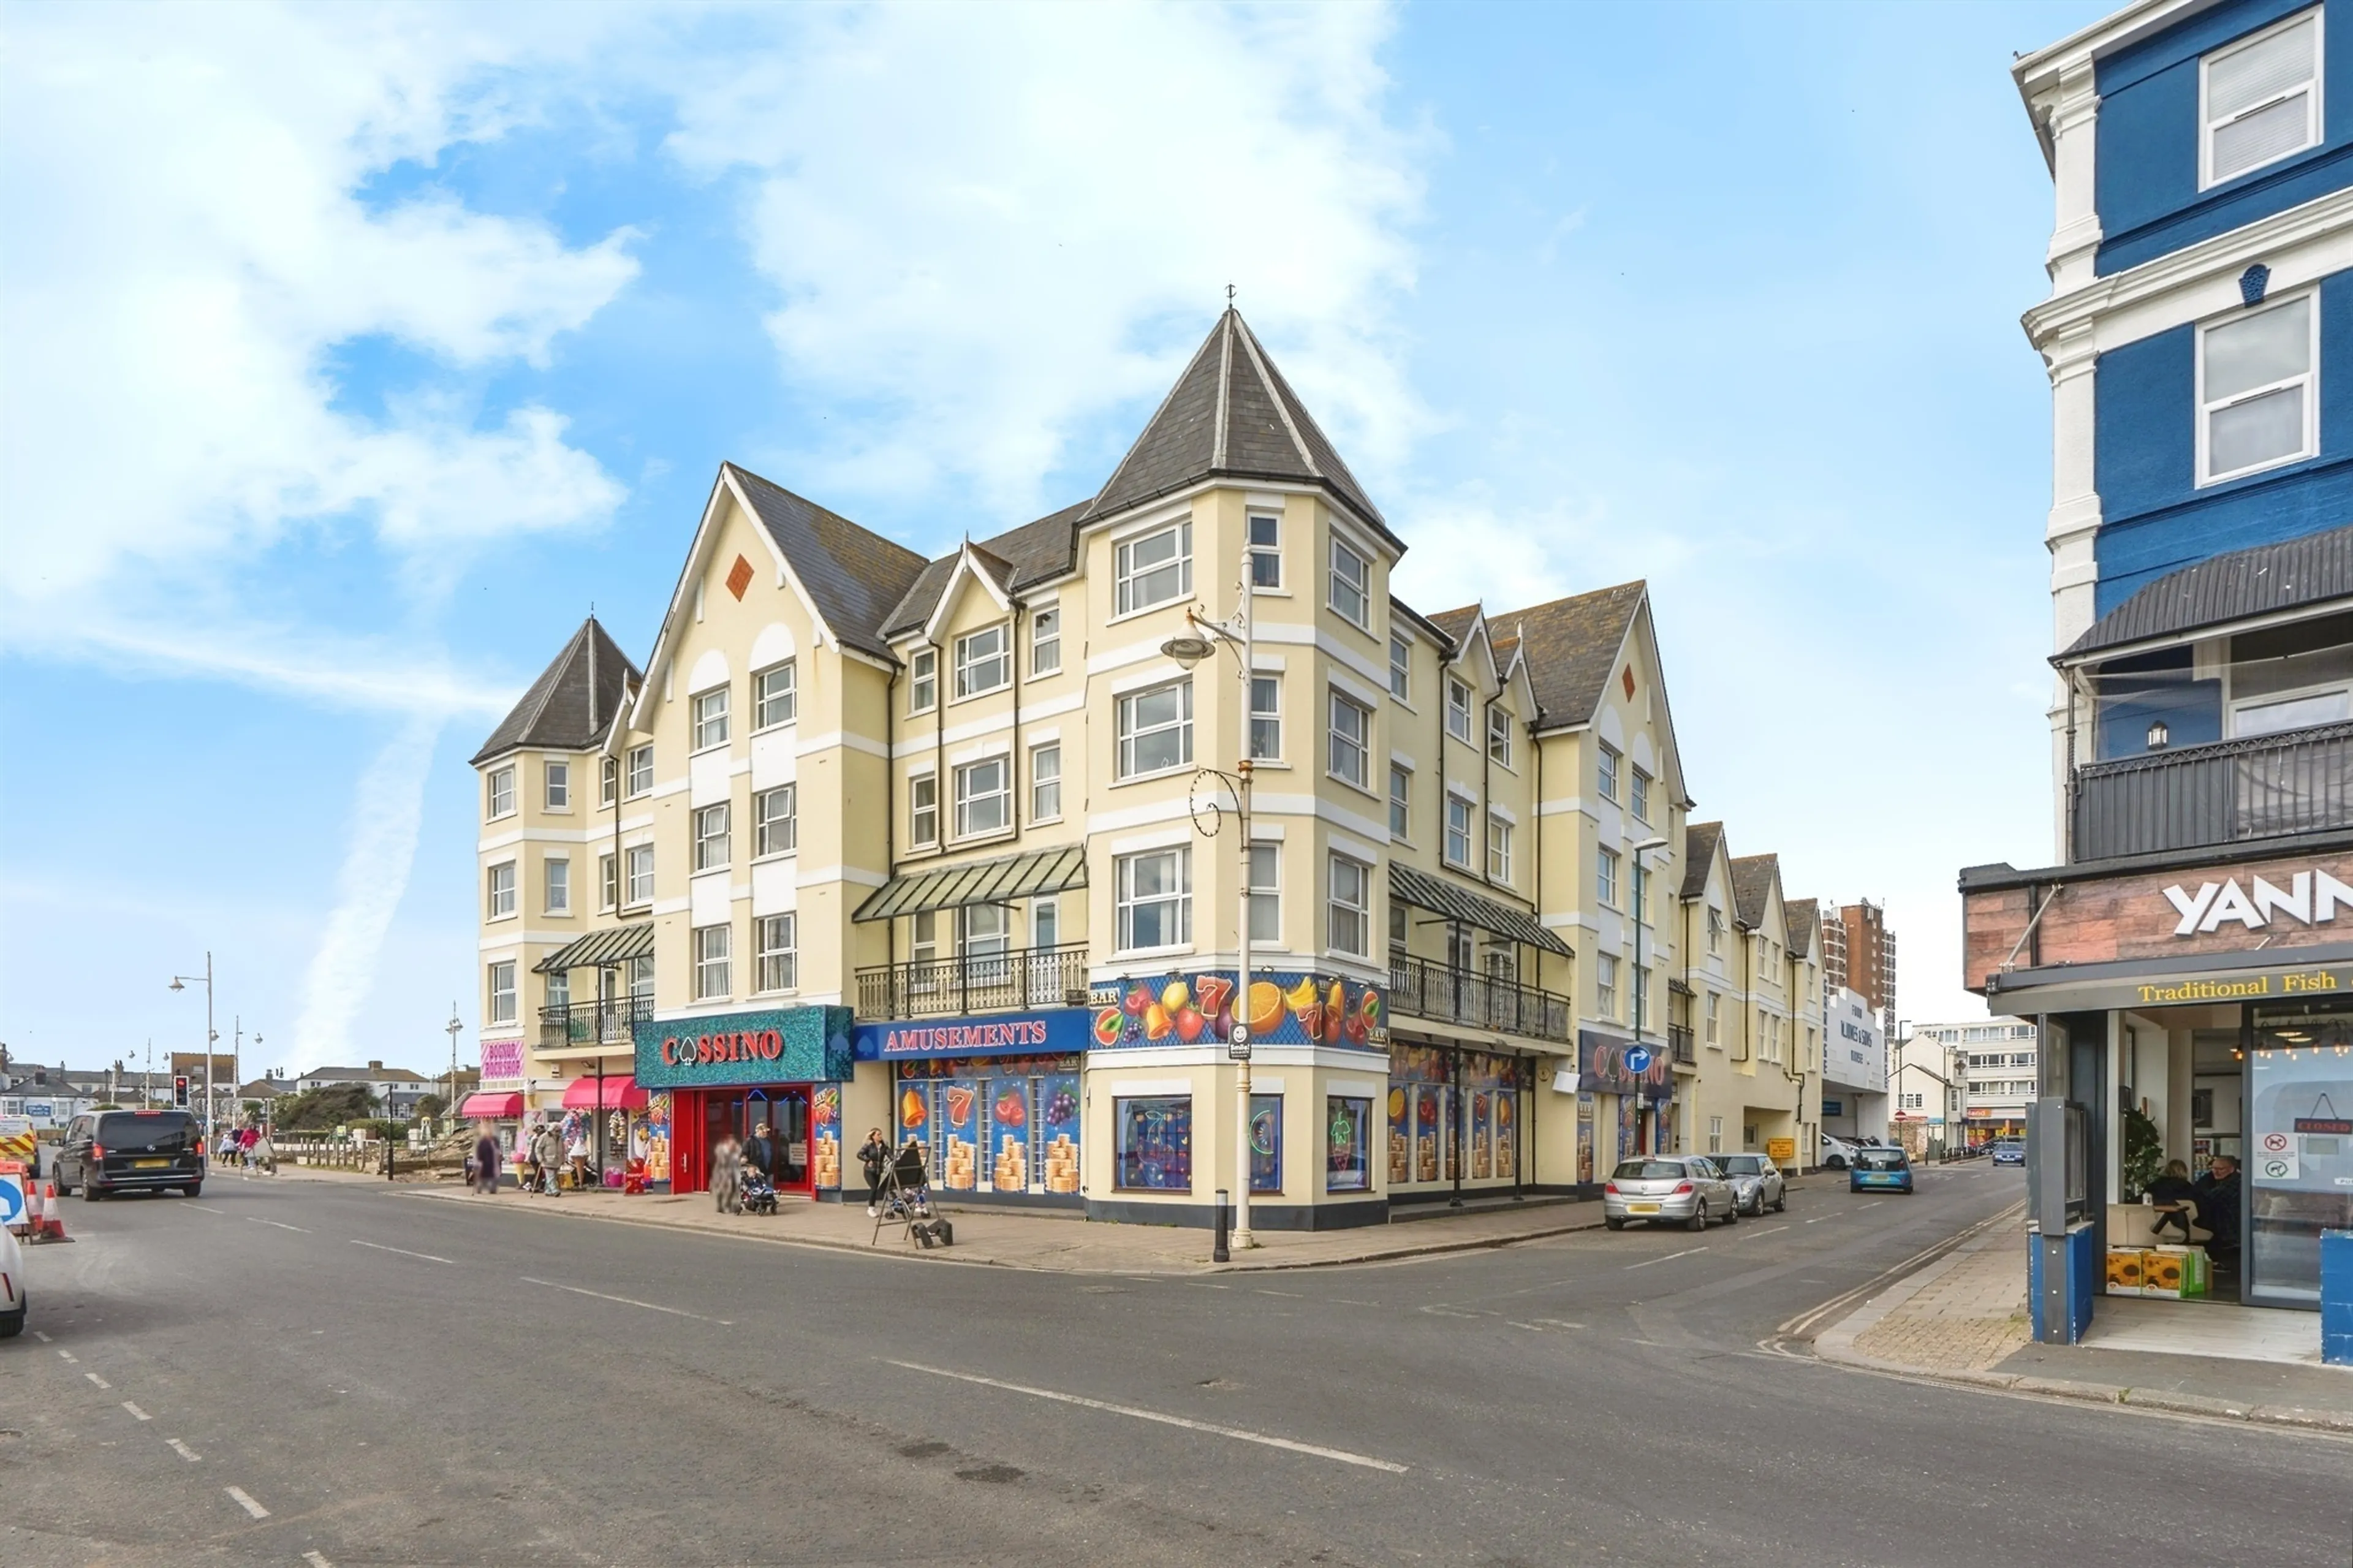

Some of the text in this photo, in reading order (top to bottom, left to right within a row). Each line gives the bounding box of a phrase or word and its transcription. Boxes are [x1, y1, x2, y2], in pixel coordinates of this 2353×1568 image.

[1089, 991, 1118, 1004] BAR
[2138, 971, 2337, 1002] Traditional Fish
[884, 1020, 1047, 1053] AMUSEMENTS
[2298, 1121, 2351, 1133] CLOSED
